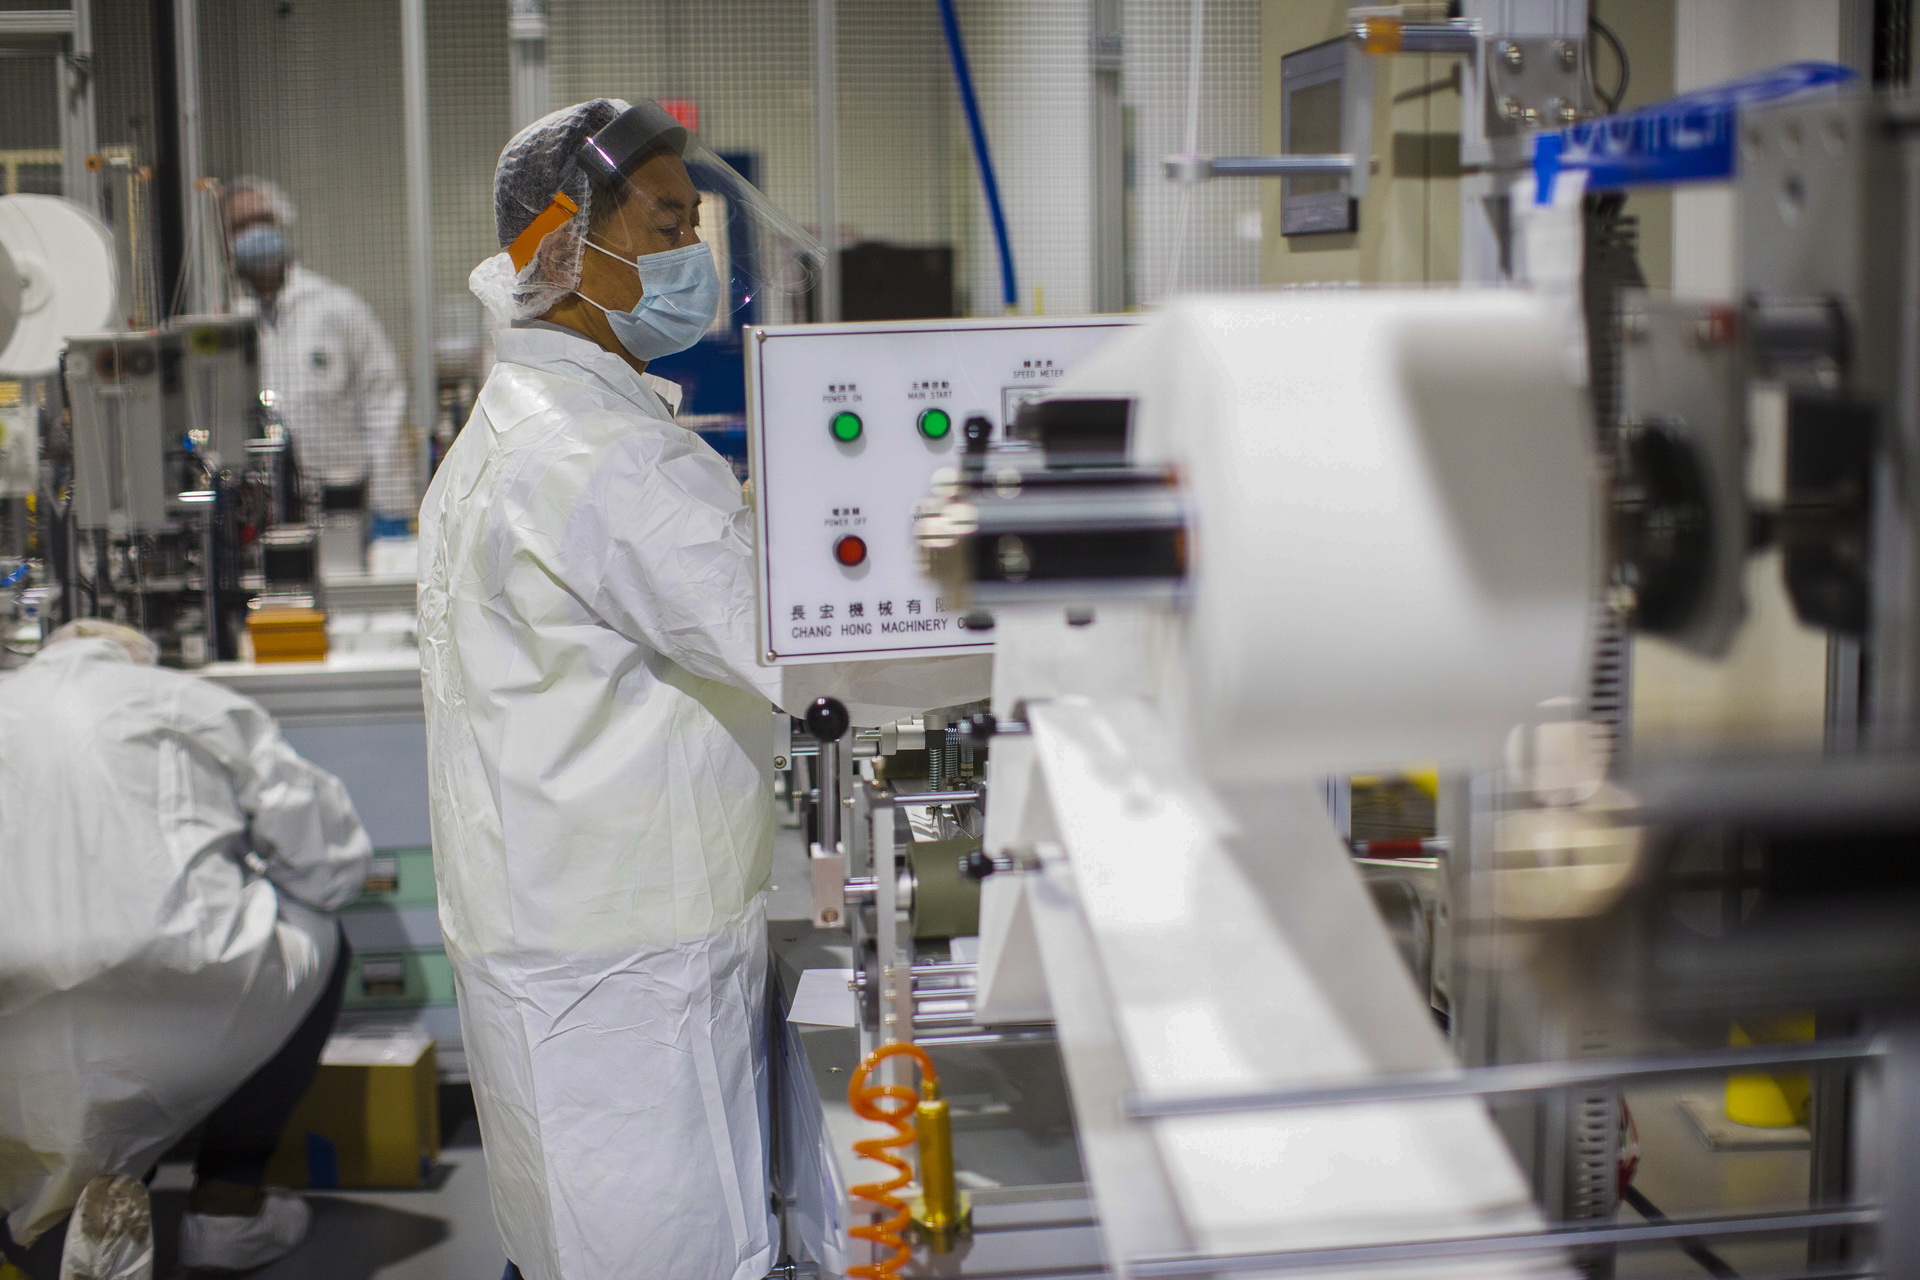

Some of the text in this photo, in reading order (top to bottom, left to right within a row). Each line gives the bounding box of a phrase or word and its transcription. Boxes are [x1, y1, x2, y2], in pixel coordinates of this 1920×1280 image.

[1012, 369, 1064, 379] SPEED METER
[822, 394, 862, 403] POWER ON
[908, 390, 952, 400] MAIN START
[824, 516, 867, 527] POWER OFF
[791, 625, 832, 639] CHANG
[841, 622, 872, 636] HONG
[881, 617, 948, 634] MACHINERY
